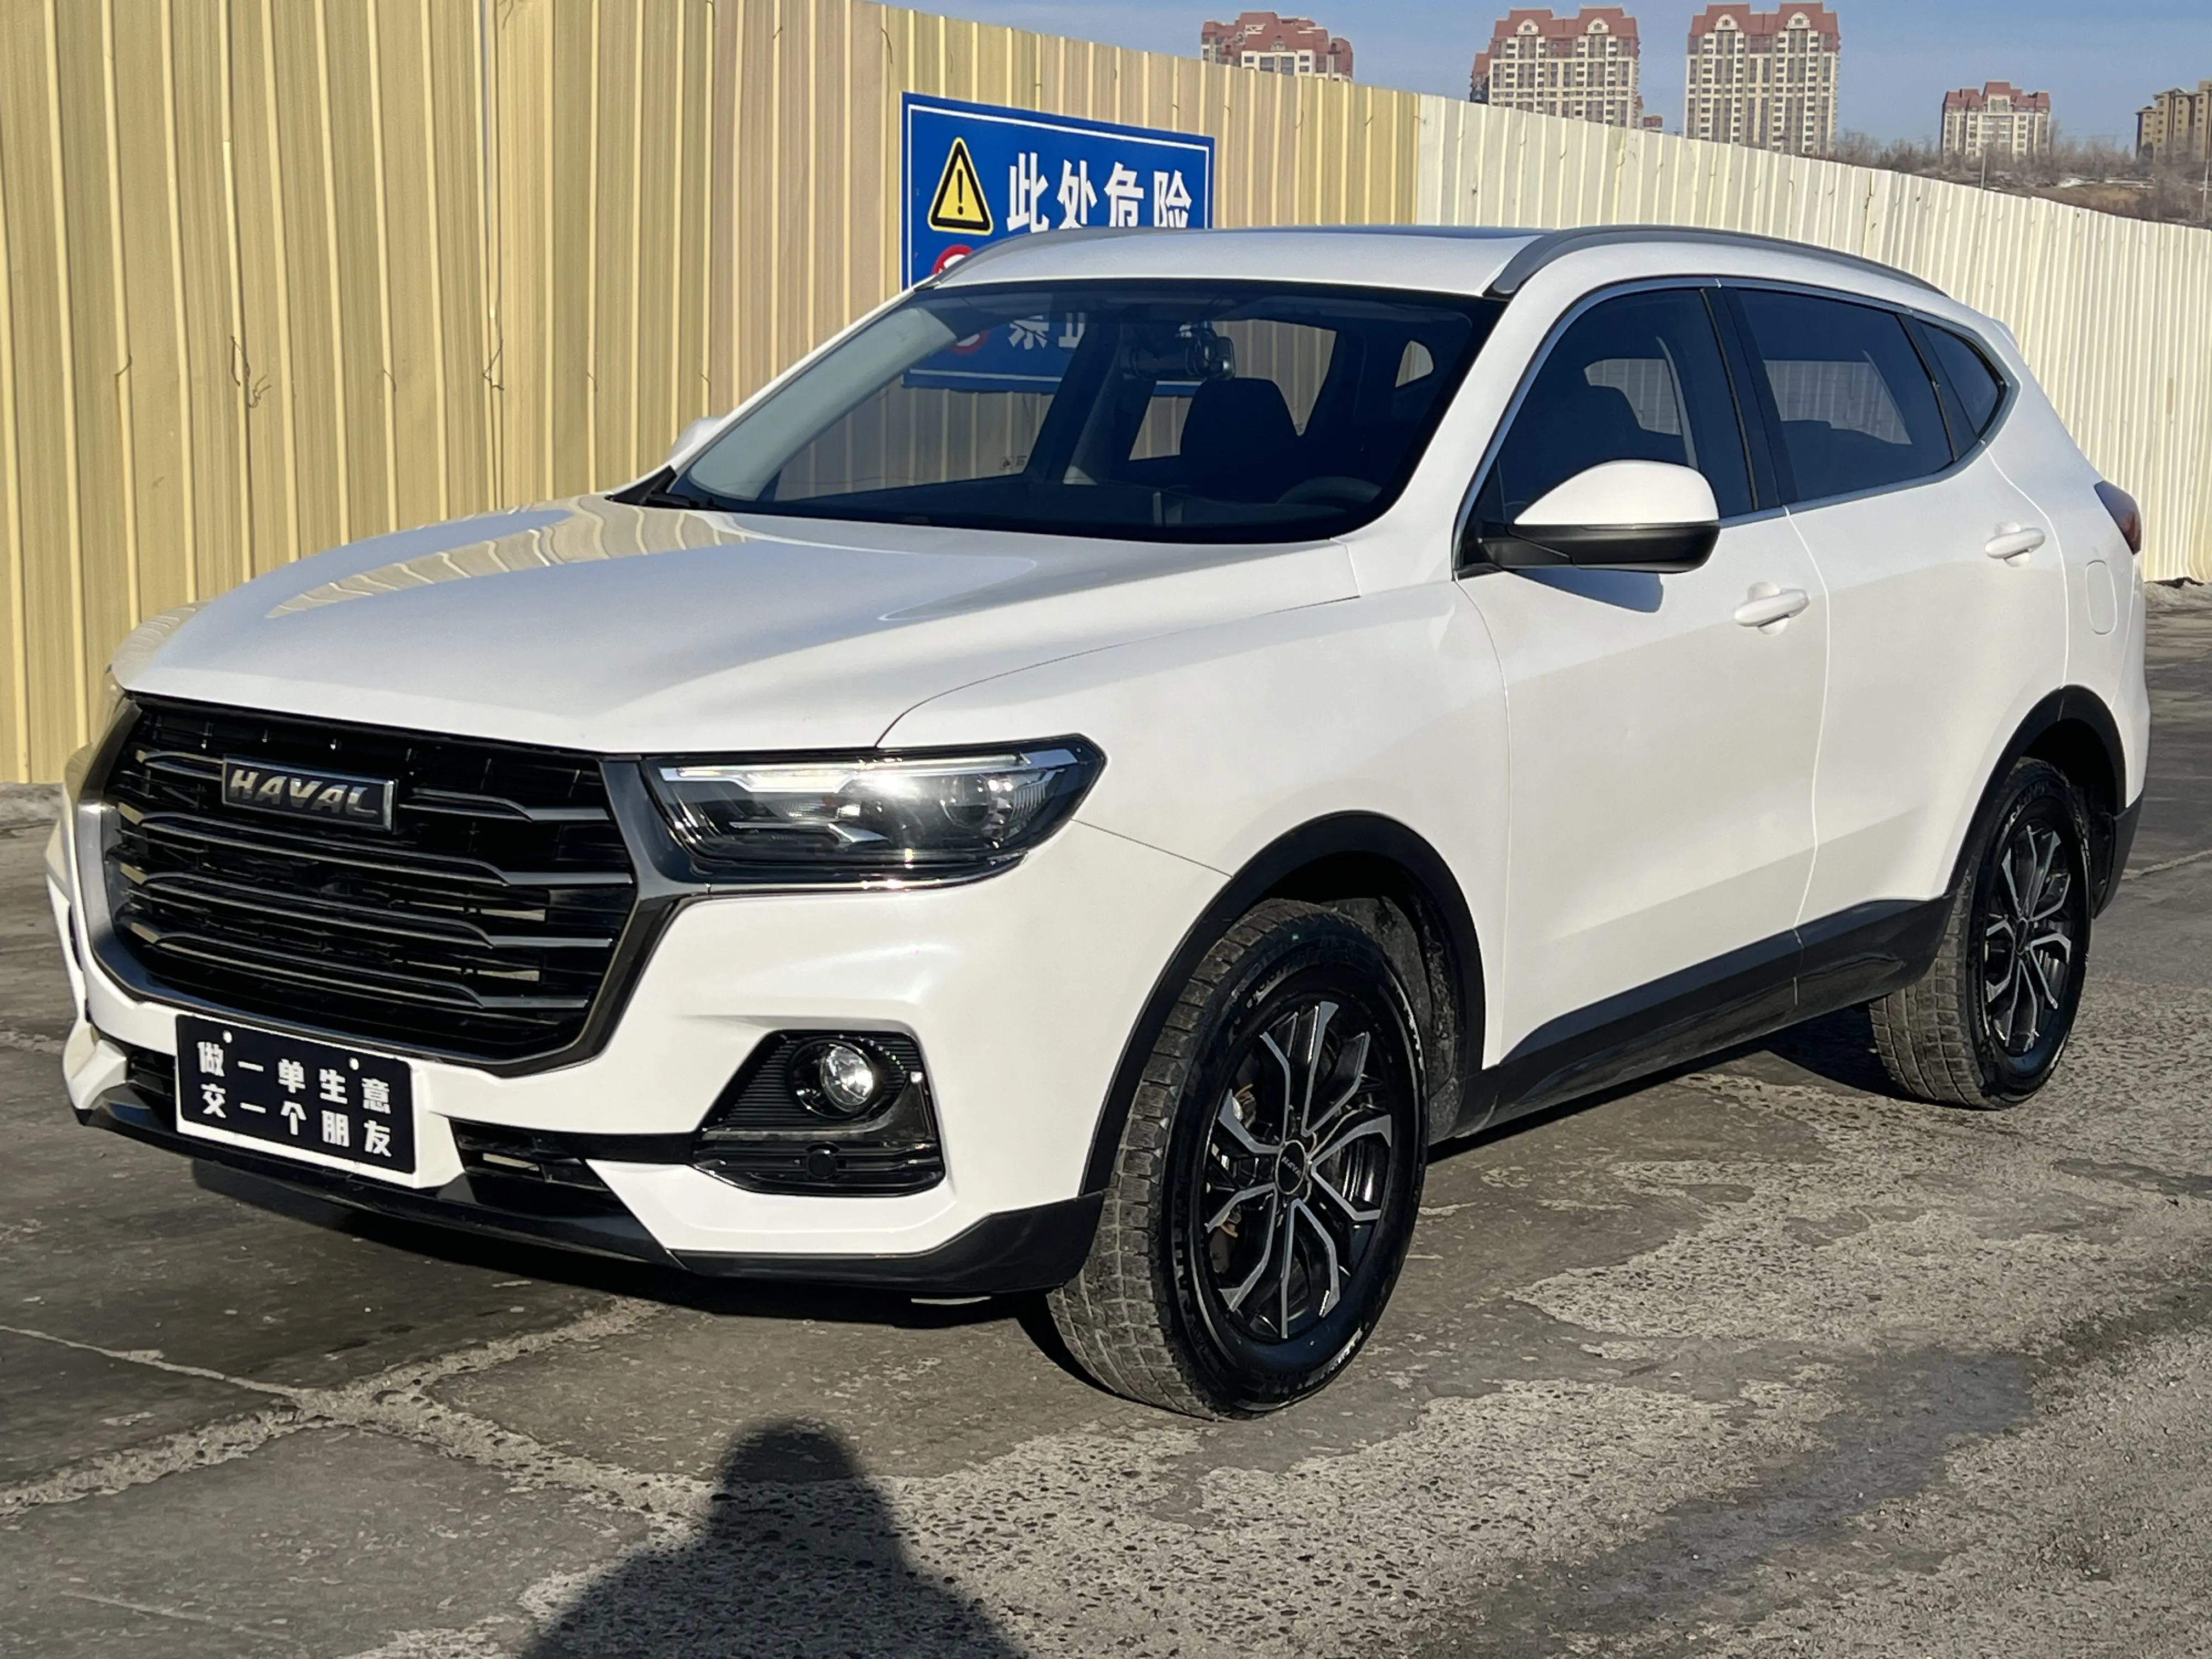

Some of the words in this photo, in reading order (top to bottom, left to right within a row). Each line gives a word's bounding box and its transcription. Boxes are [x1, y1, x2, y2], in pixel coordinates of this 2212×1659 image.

[1007, 152, 1192, 234] 此处危险
[228, 769, 378, 817] HAVAL
[196, 1041, 391, 1114] 做一单生意
[200, 1084, 392, 1158] 交一个朋友
